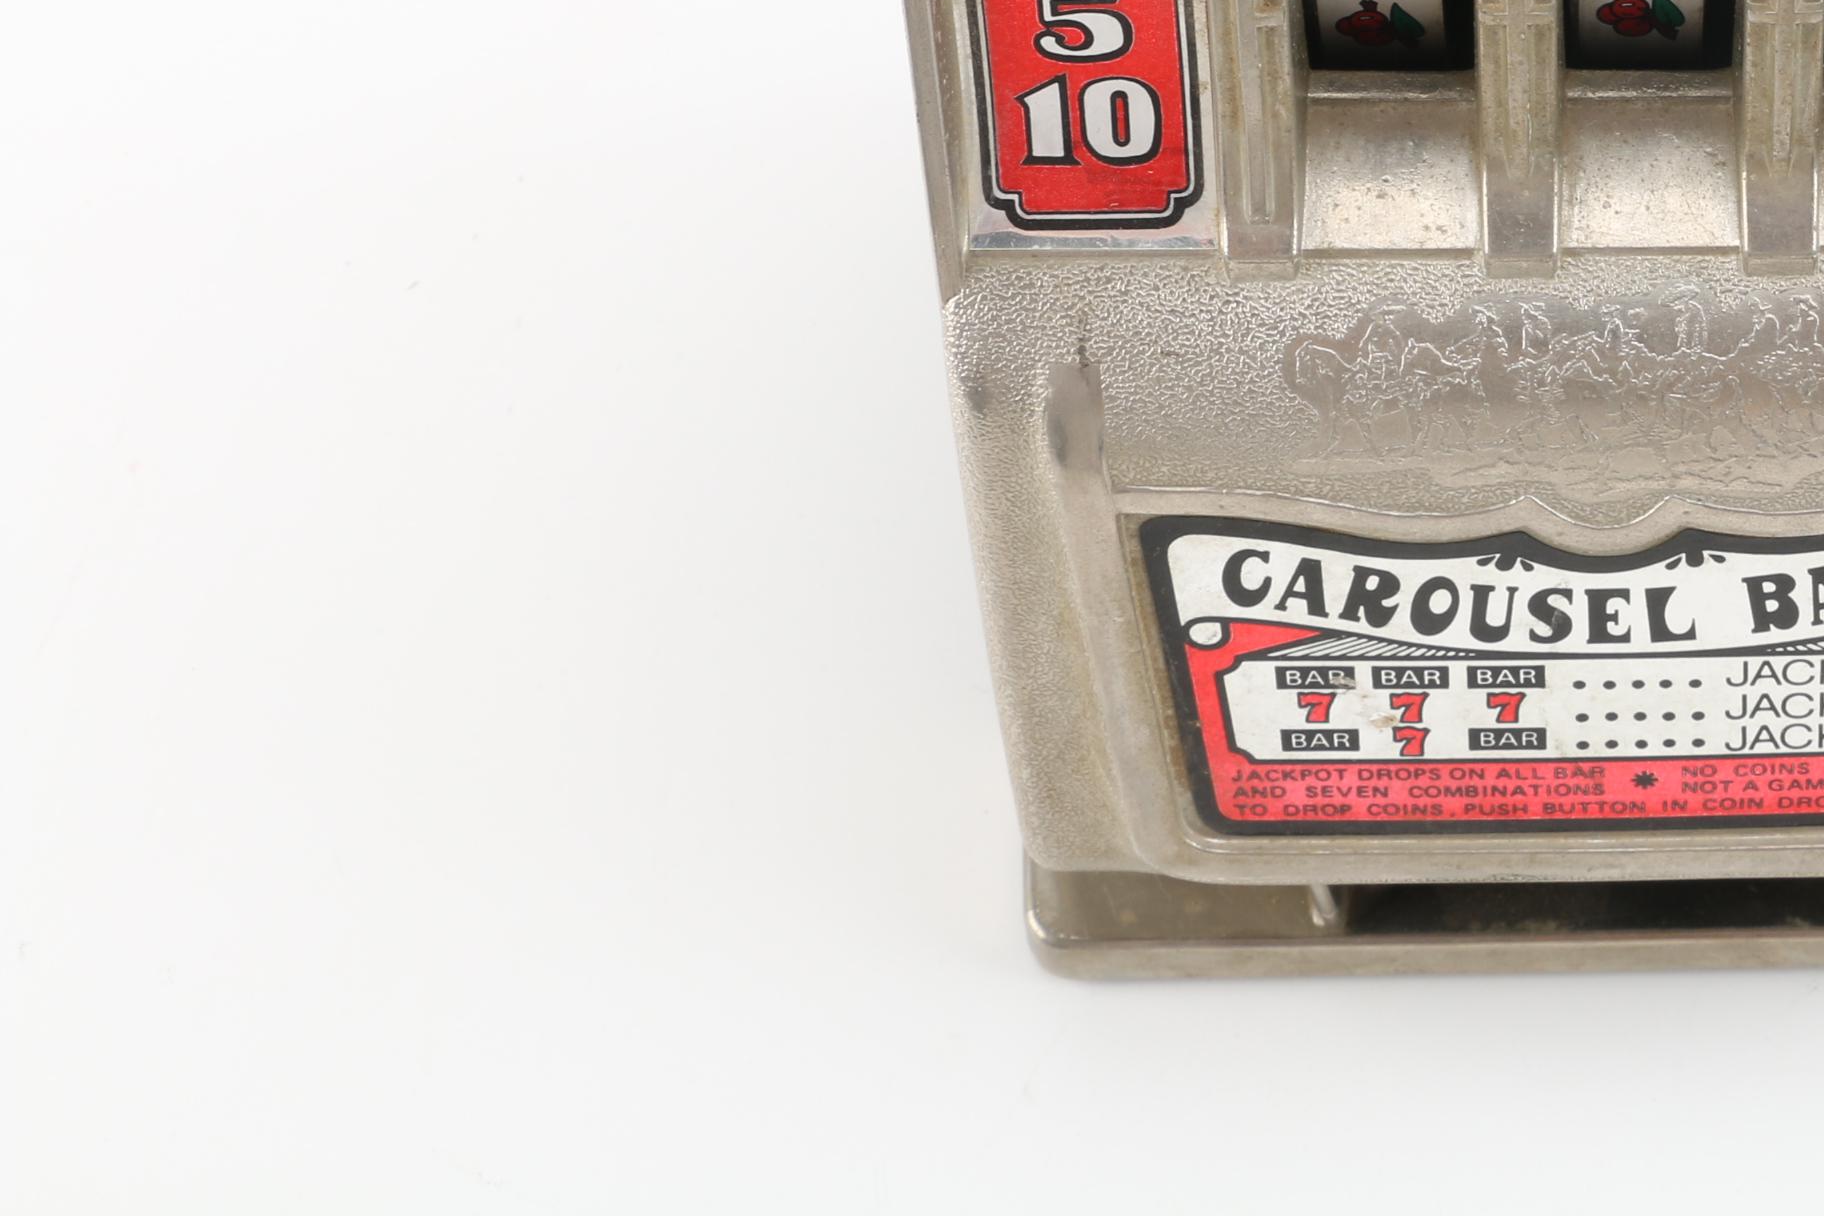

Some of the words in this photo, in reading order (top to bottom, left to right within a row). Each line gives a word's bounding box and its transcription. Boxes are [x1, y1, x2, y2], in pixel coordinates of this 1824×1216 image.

[1013, 72, 1163, 168] 10
[1221, 548, 1697, 644] CAROUSEL
[1380, 669, 1441, 686] BAR
[1476, 668, 1536, 684] BAR
[1297, 691, 1337, 723] 7
[1389, 691, 1430, 723] 7
[1486, 691, 1527, 723] 7
[1291, 732, 1350, 748] BAR
[1392, 726, 1431, 757] 7
[1480, 731, 1538, 747] BAR
[1231, 768, 1348, 782] JACKPOT
[1357, 767, 1441, 782] DROPS
[1449, 767, 1485, 781] ON
[1496, 766, 1545, 780] ALL
[1553, 765, 1606, 780] BAR
[1681, 763, 1718, 778] NO
[1733, 762, 1811, 777] COINS
[1233, 785, 1287, 799] AND
[1305, 785, 1390, 799] SEVEN
[1408, 783, 1606, 800] COMBINATIONS
[1681, 780, 1734, 795] NOT
[1742, 779, 1760, 793] A
[1233, 803, 1268, 817] TO
[1283, 803, 1353, 817] DROP
[1463, 802, 1529, 816] PUSH
[1542, 800, 1647, 816] BUTTON
[1662, 799, 1689, 812] IN
[1702, 796, 1765, 811] COIN
